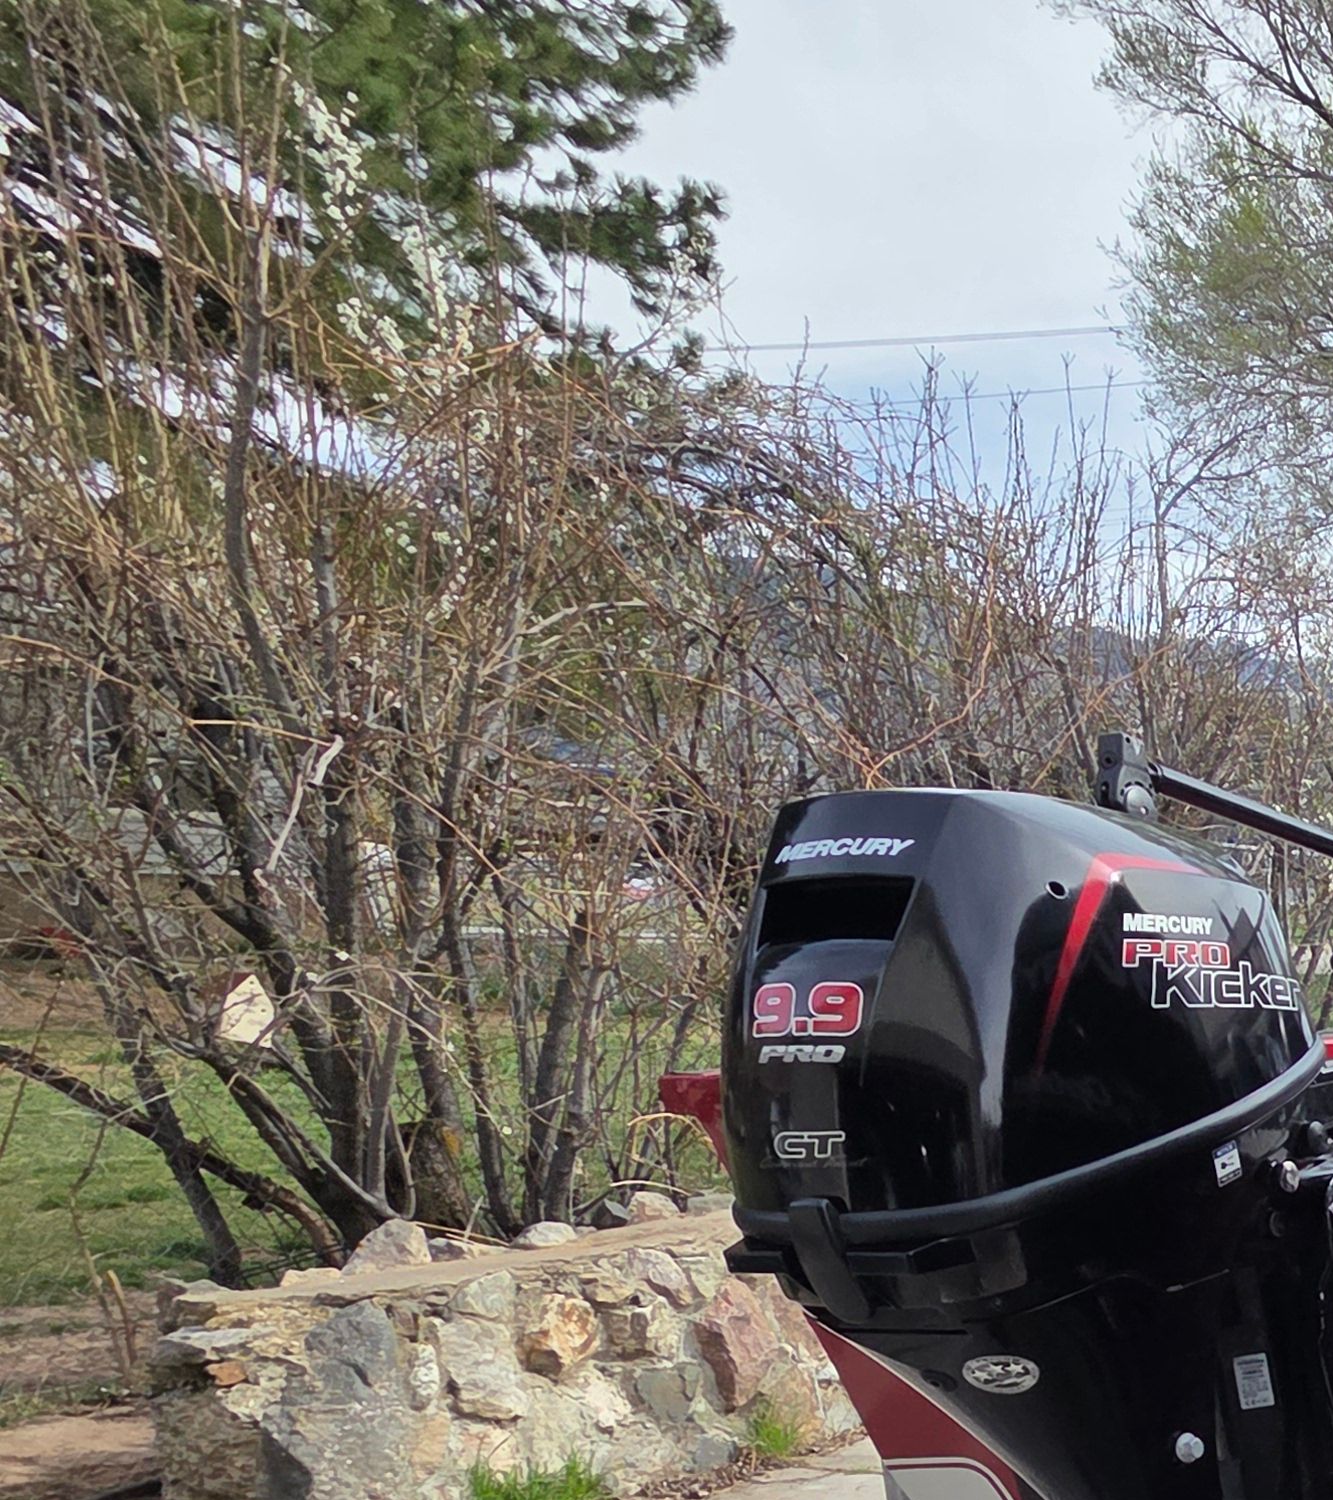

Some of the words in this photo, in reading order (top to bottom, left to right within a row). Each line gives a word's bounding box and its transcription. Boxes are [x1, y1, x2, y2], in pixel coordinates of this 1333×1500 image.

[774, 837, 915, 864] MERCURY
[1123, 913, 1213, 935] MERCURY
[1122, 938, 1231, 969] PRO
[1151, 959, 1300, 1011] Kicker
[753, 982, 864, 1038] 9.9
[758, 1045, 846, 1064] PRO
[773, 1131, 846, 1159] CT
